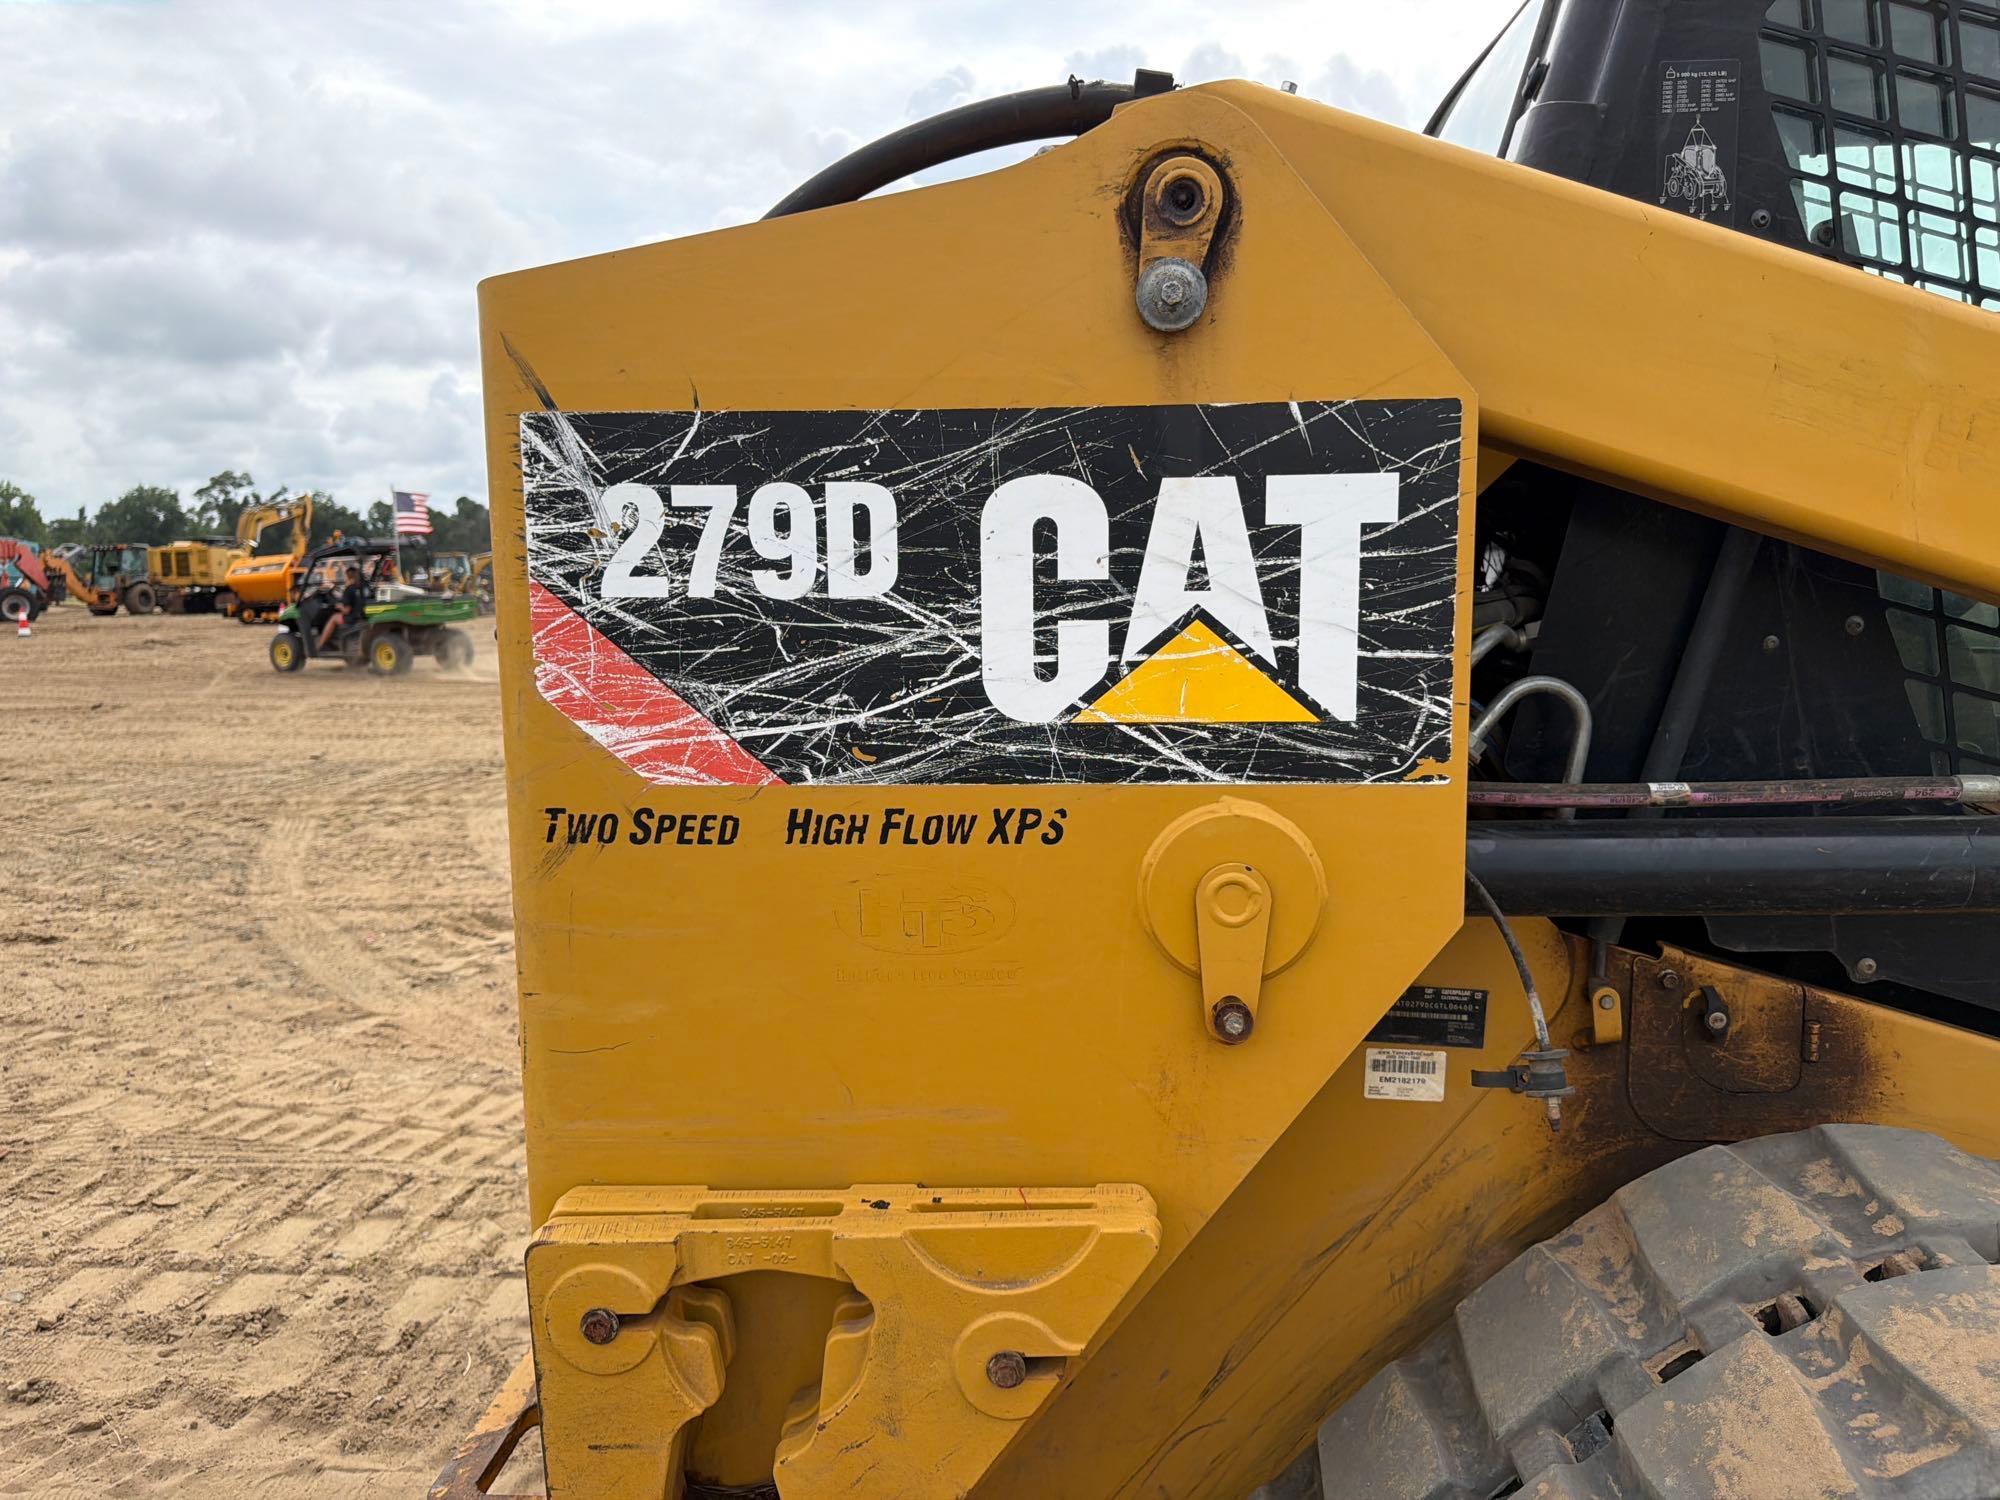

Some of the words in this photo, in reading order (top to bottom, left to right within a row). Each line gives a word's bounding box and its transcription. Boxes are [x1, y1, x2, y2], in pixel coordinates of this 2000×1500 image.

[600, 481, 900, 600] 279D
[980, 471, 1400, 725] CAT
[987, 808, 1068, 845] XPS
